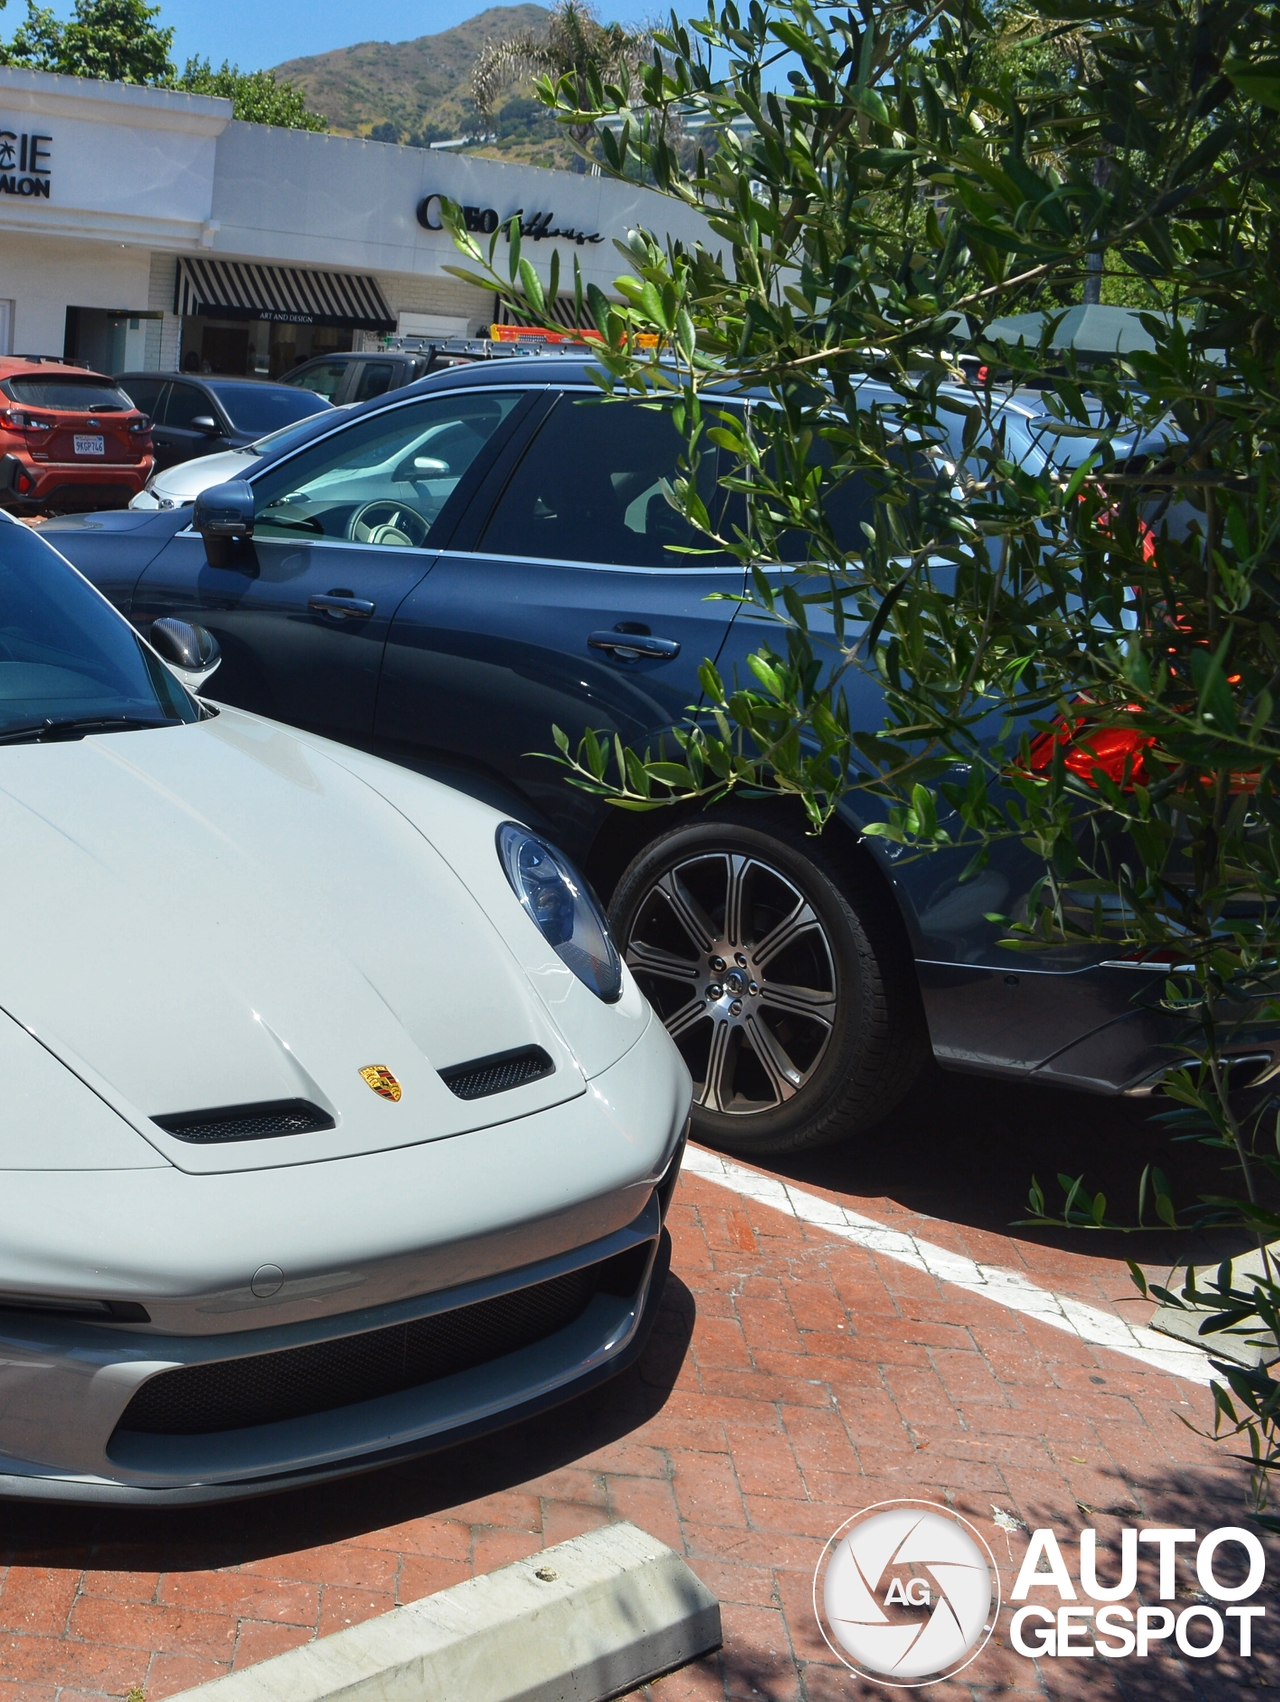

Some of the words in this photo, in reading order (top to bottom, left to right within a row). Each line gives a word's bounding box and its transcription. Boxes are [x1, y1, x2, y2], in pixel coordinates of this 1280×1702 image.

[416, 193, 499, 234] CEO
[260, 312, 273, 320] ART
[273, 313, 289, 321] AND
[289, 314, 314, 323] DESIGN
[76, 441, 103, 452] 9KGP746
